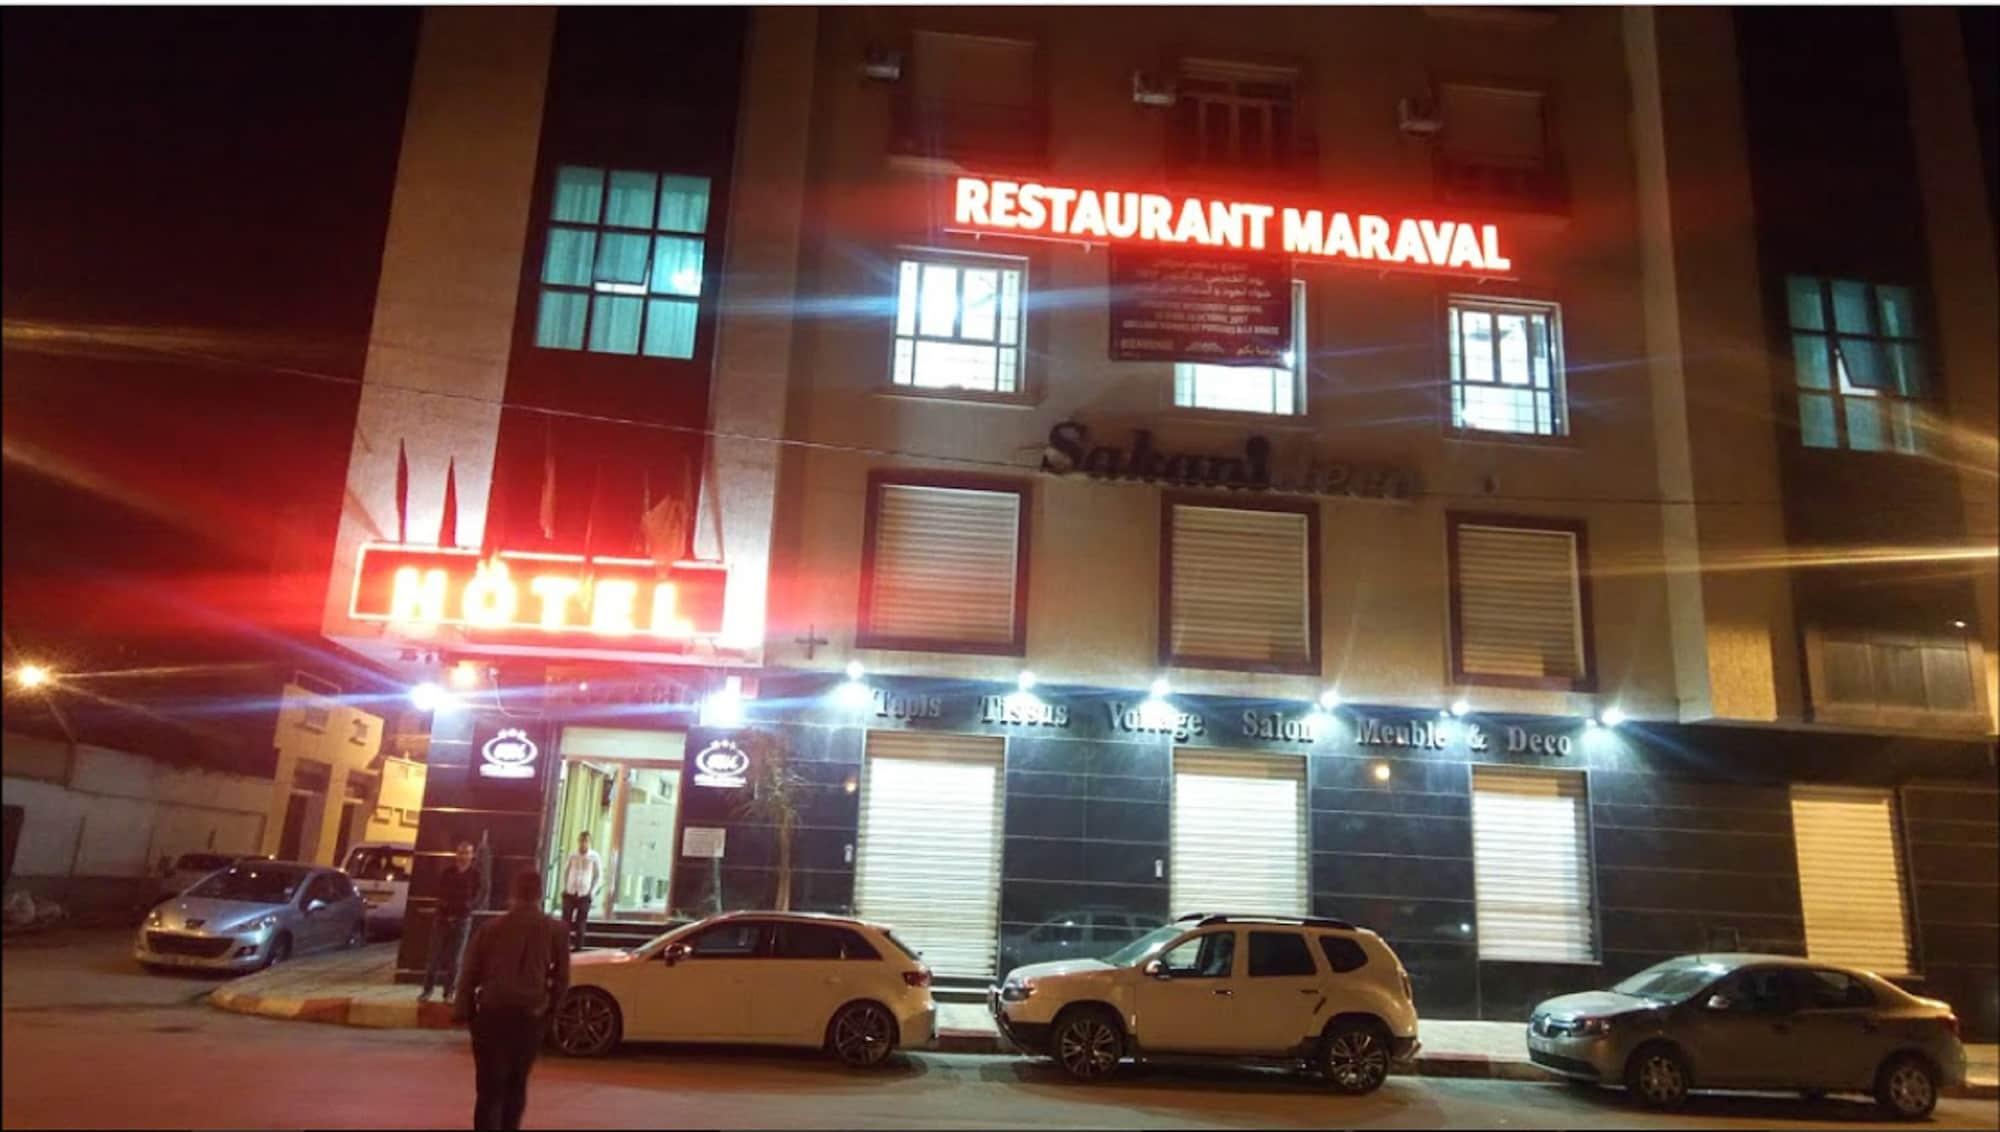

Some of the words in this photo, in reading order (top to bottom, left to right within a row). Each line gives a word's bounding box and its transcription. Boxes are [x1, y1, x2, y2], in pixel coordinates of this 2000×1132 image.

[954, 177, 1272, 249] RESTAURANT
[1281, 207, 1512, 271] MARAVAL
[872, 688, 941, 722] Tapis
[981, 694, 1069, 726] Tissus
[1105, 699, 1203, 740] Voge
[1242, 709, 1314, 741] Salon
[1354, 717, 1450, 749] Meuble
[1467, 723, 1488, 749] &
[1506, 725, 1573, 756] Deco
